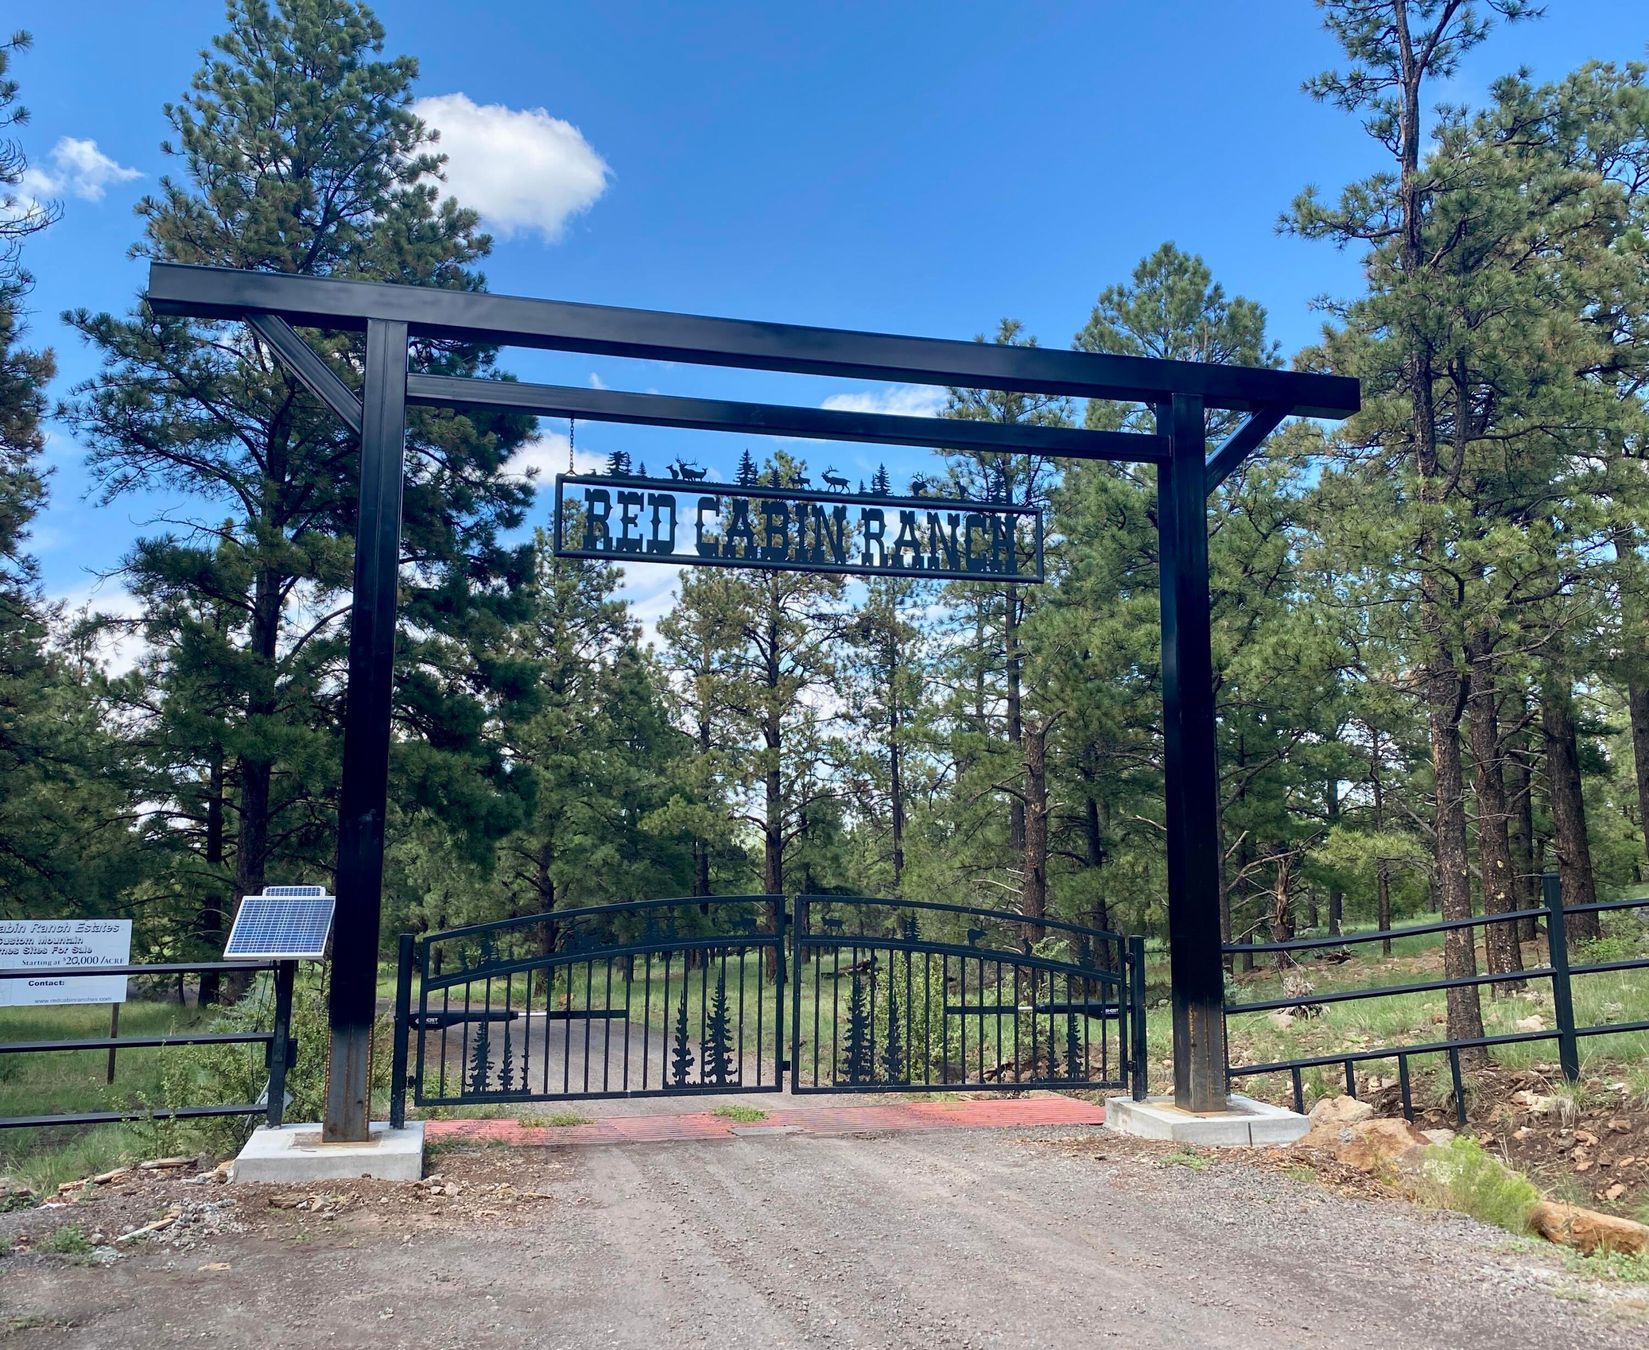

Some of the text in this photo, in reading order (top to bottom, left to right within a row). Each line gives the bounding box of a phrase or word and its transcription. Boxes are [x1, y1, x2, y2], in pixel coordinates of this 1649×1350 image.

[583, 488, 1018, 575] RED CABIN RANCH
[30, 922, 72, 934] Ranch
[75, 922, 120, 933] Estates
[38, 936, 84, 945] Mountain
[23, 946, 48, 955] Sites
[51, 946, 69, 955] For
[71, 946, 93, 954] Sale
[63, 955, 99, 966] $20,000
